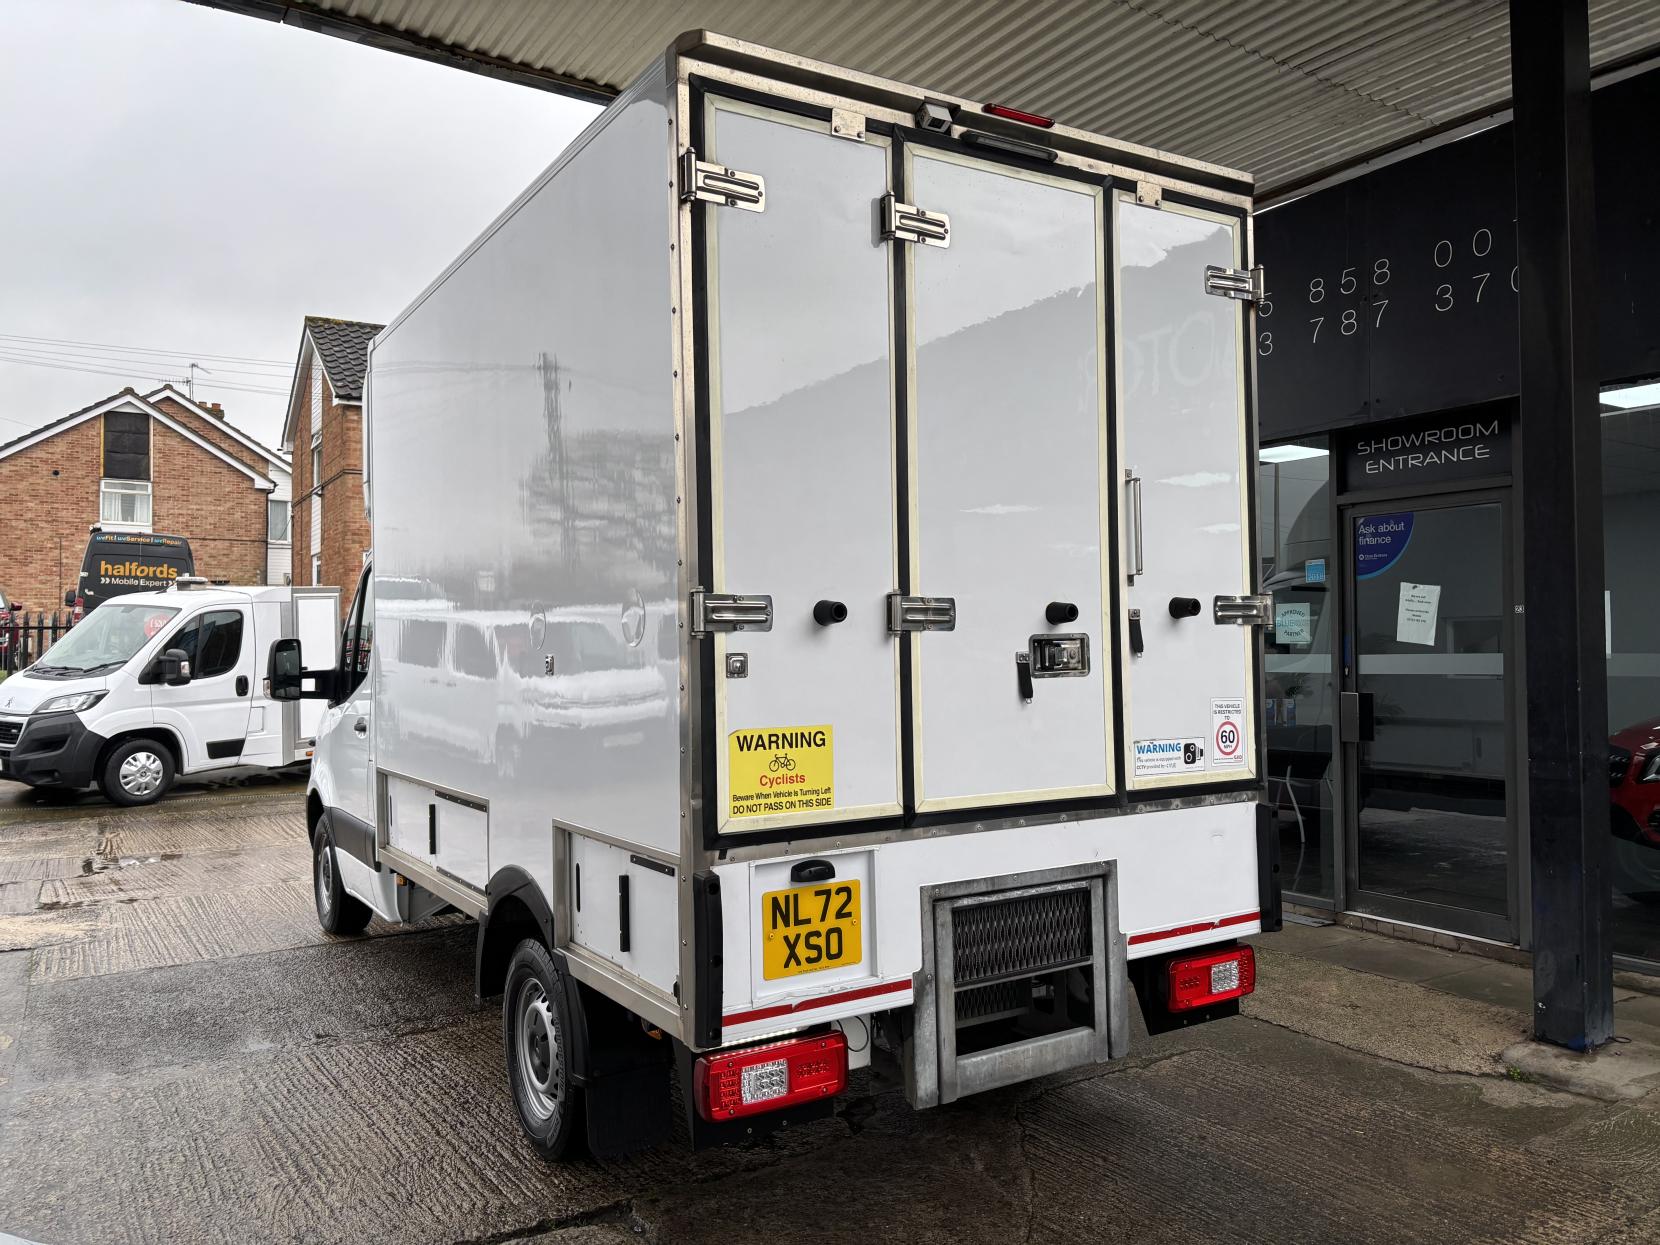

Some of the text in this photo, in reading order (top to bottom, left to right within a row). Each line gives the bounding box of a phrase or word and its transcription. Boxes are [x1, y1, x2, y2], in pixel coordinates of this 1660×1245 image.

[1309, 258, 1391, 304] 858
[1258, 331, 1273, 356] 3
[1309, 300, 1389, 343] 787
[1357, 420, 1499, 456] SHOWROOM
[1366, 444, 1490, 474] ENTRANCE
[1358, 521, 1405, 534] Ask about
[1358, 536, 1392, 545] finance
[100, 560, 178, 579] halfords
[111, 577, 167, 587] Mobile Expert
[736, 730, 826, 752] WARNING
[1220, 729, 1235, 744] 60
[1136, 743, 1182, 754] WARNING
[759, 773, 806, 789] Cyclists
[732, 786, 832, 802] Beware When Vehicle Is Turning Left
[732, 797, 832, 815] DO NOT PASS ON THIS SIDE
[783, 926, 843, 969] XSO
